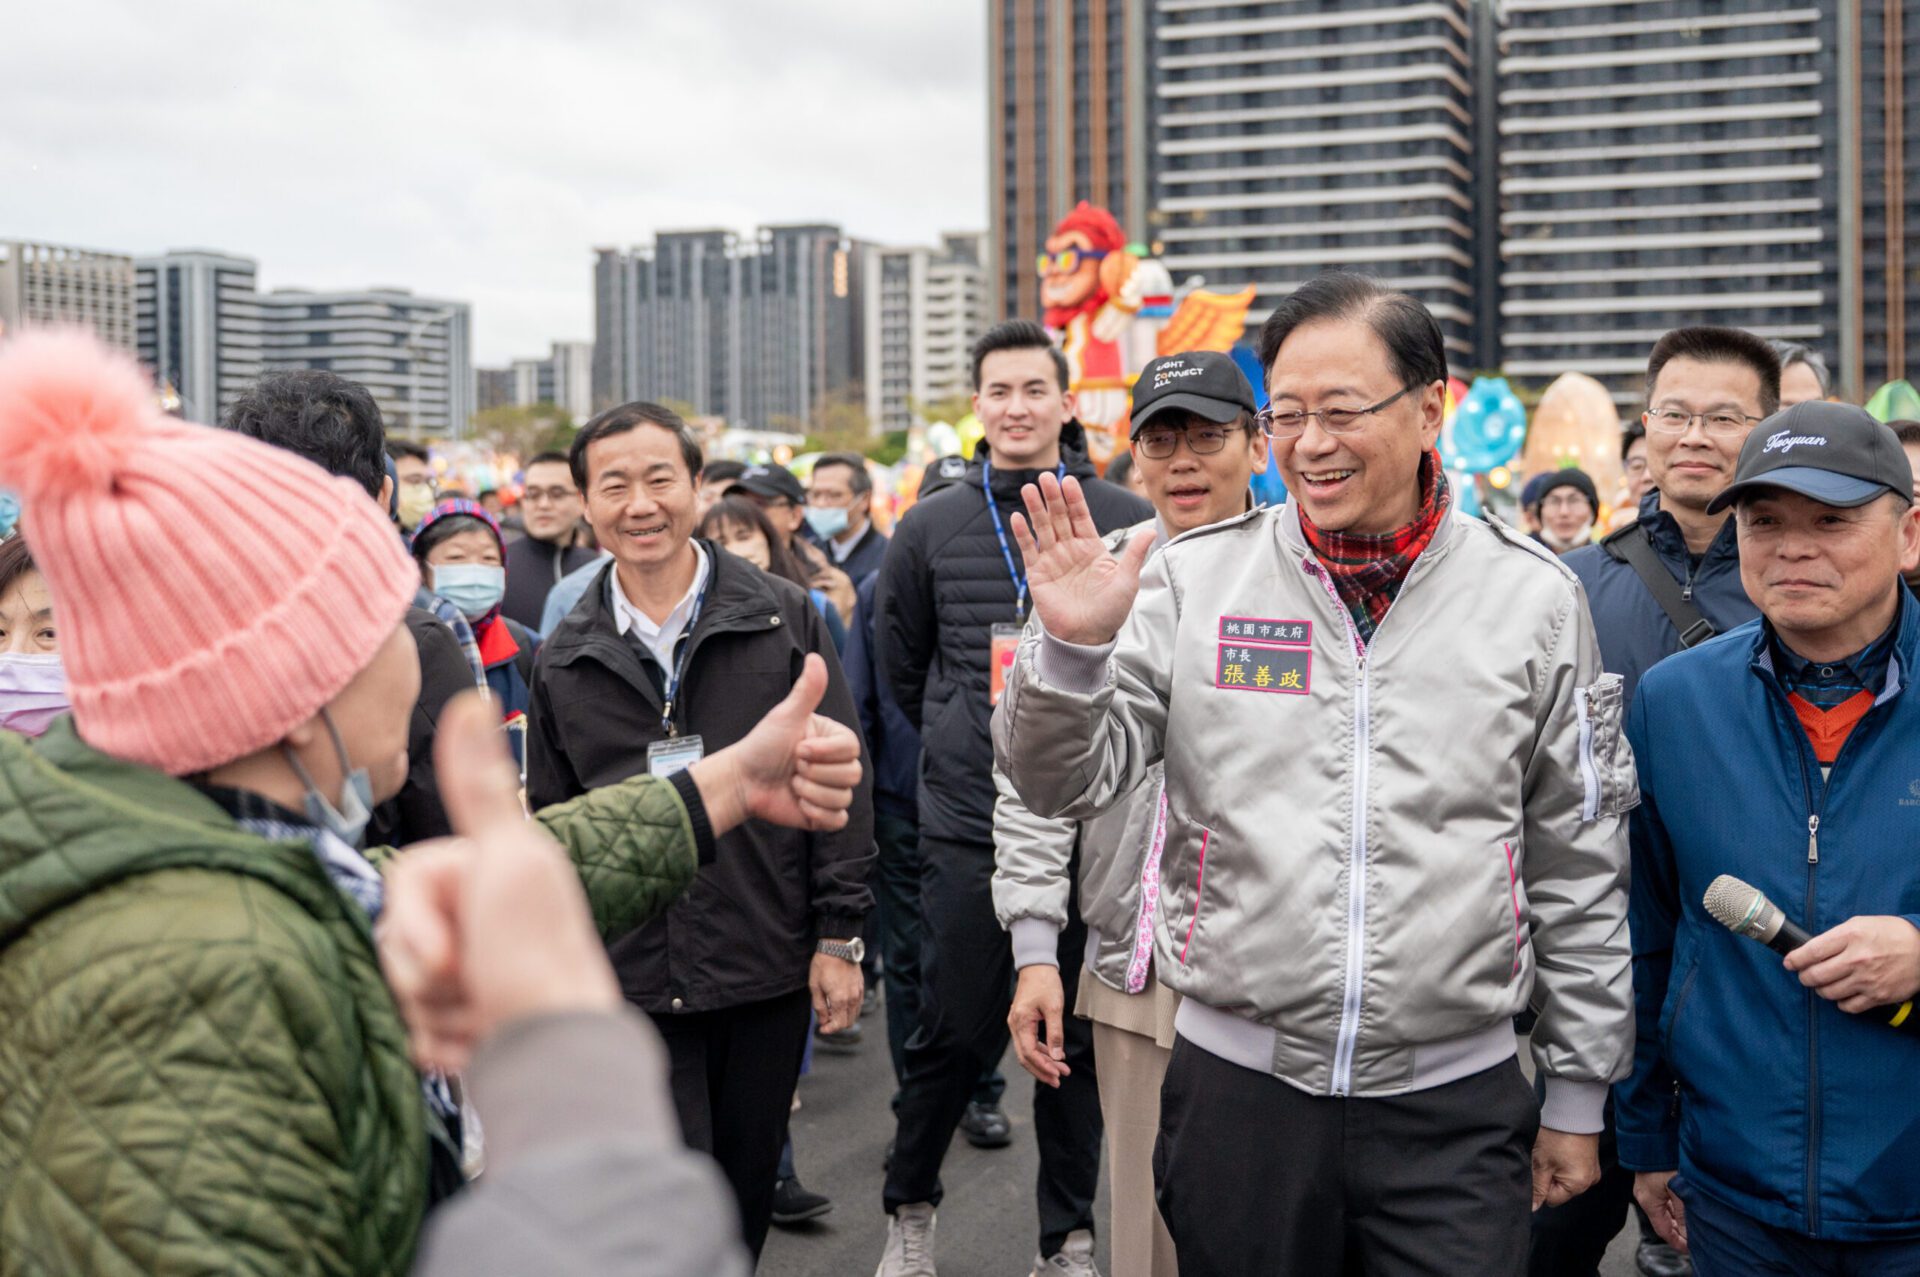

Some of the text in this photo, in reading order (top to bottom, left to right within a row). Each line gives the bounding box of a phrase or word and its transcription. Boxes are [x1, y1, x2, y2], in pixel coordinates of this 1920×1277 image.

[1154, 367, 1204, 382] CONNECT
[1153, 378, 1171, 390] ALL
[1763, 429, 1827, 453] Taoyuan
[1225, 622, 1304, 639] 桃園市政府
[1225, 647, 1251, 662] 市長
[1224, 663, 1303, 689] 張善政
